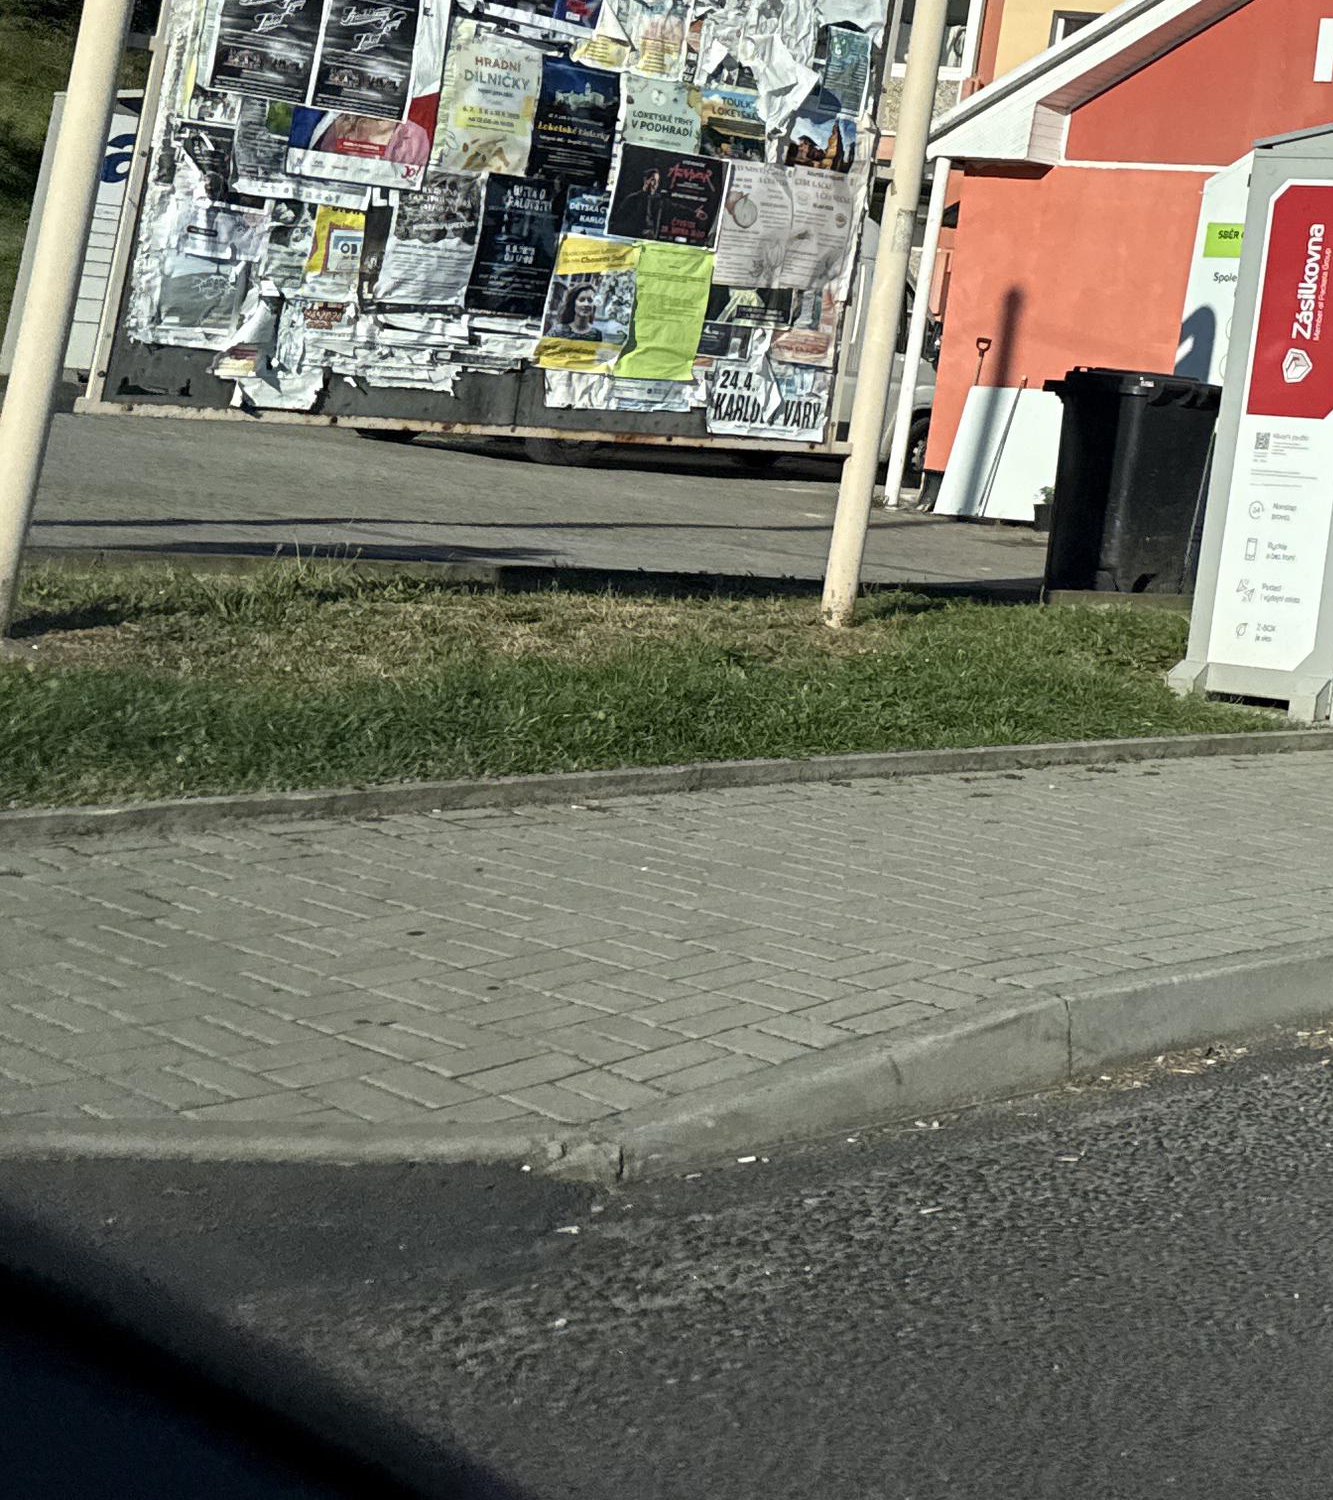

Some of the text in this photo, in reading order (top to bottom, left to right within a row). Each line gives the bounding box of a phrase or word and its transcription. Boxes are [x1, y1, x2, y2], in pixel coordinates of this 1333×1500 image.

[475, 55, 521, 73] HRADNÍ
[464, 68, 530, 90] DÍLNIČKY
[631, 119, 693, 137] V PODHRADÍ
[1291, 223, 1325, 340] Zásilkovna
[783, 399, 821, 429] VARY
